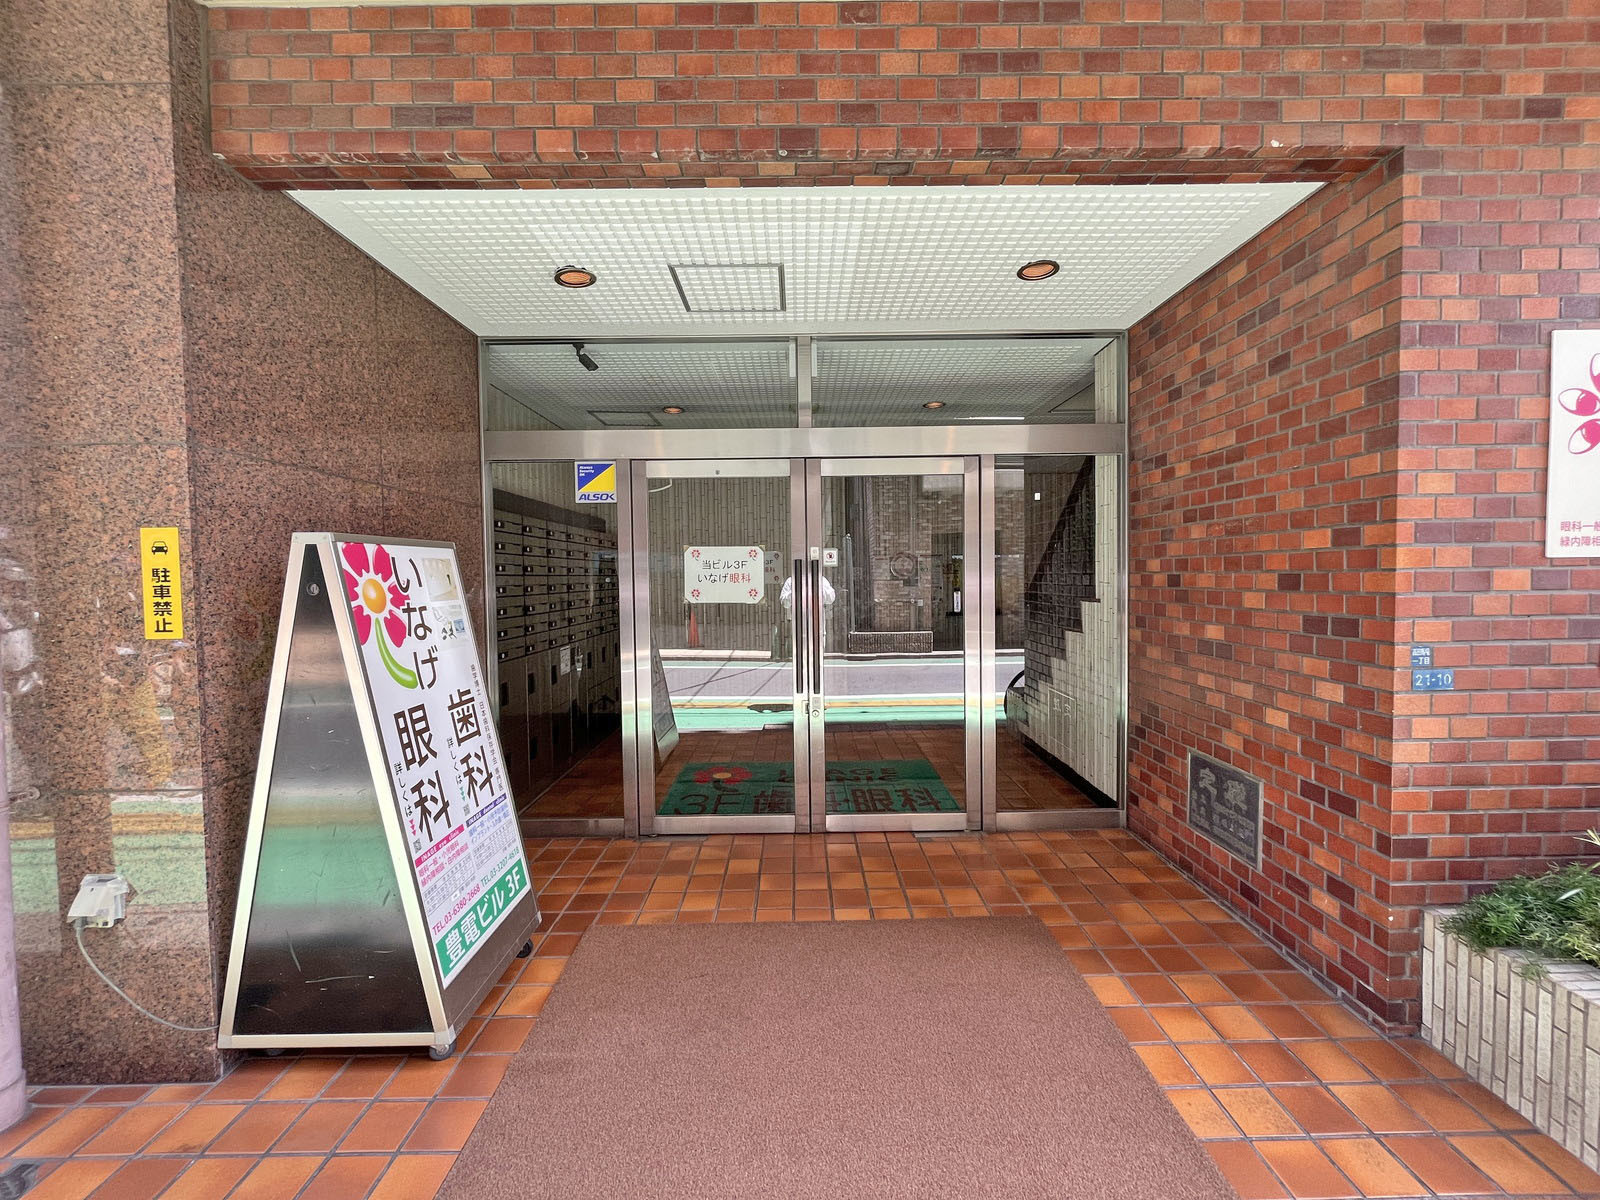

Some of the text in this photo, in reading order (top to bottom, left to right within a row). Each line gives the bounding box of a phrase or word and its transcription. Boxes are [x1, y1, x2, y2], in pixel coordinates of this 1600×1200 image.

[579, 493, 615, 501] ALSOK
[697, 573, 751, 583] いなげ眼科
[702, 560, 748, 569] 当ビル3F
[151, 567, 174, 633] 駐車禁止
[391, 556, 438, 690] いなげ
[1415, 673, 1452, 686] 21-10
[393, 703, 452, 843] 眼科
[447, 688, 495, 808] 歯科
[445, 886, 505, 968] 豊電ビル
[505, 866, 521, 898] 3F
